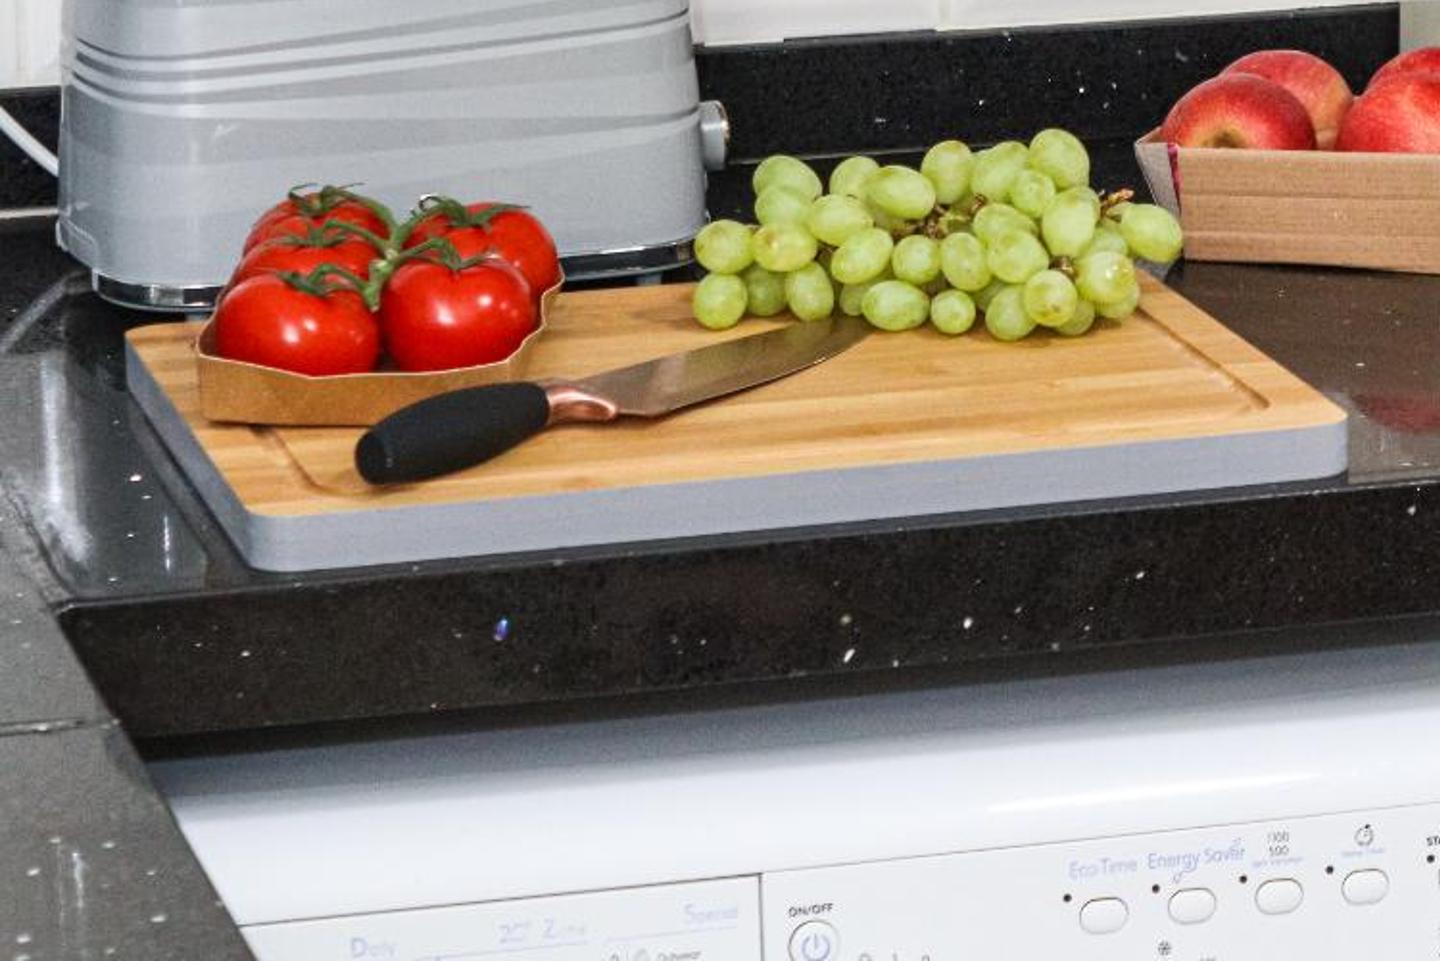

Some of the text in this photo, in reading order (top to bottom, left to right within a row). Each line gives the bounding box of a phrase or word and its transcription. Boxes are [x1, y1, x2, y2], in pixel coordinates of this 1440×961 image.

[1147, 851, 1201, 876] Energy
[1203, 843, 1246, 865] Saver
[788, 902, 834, 919] ON/OFF
